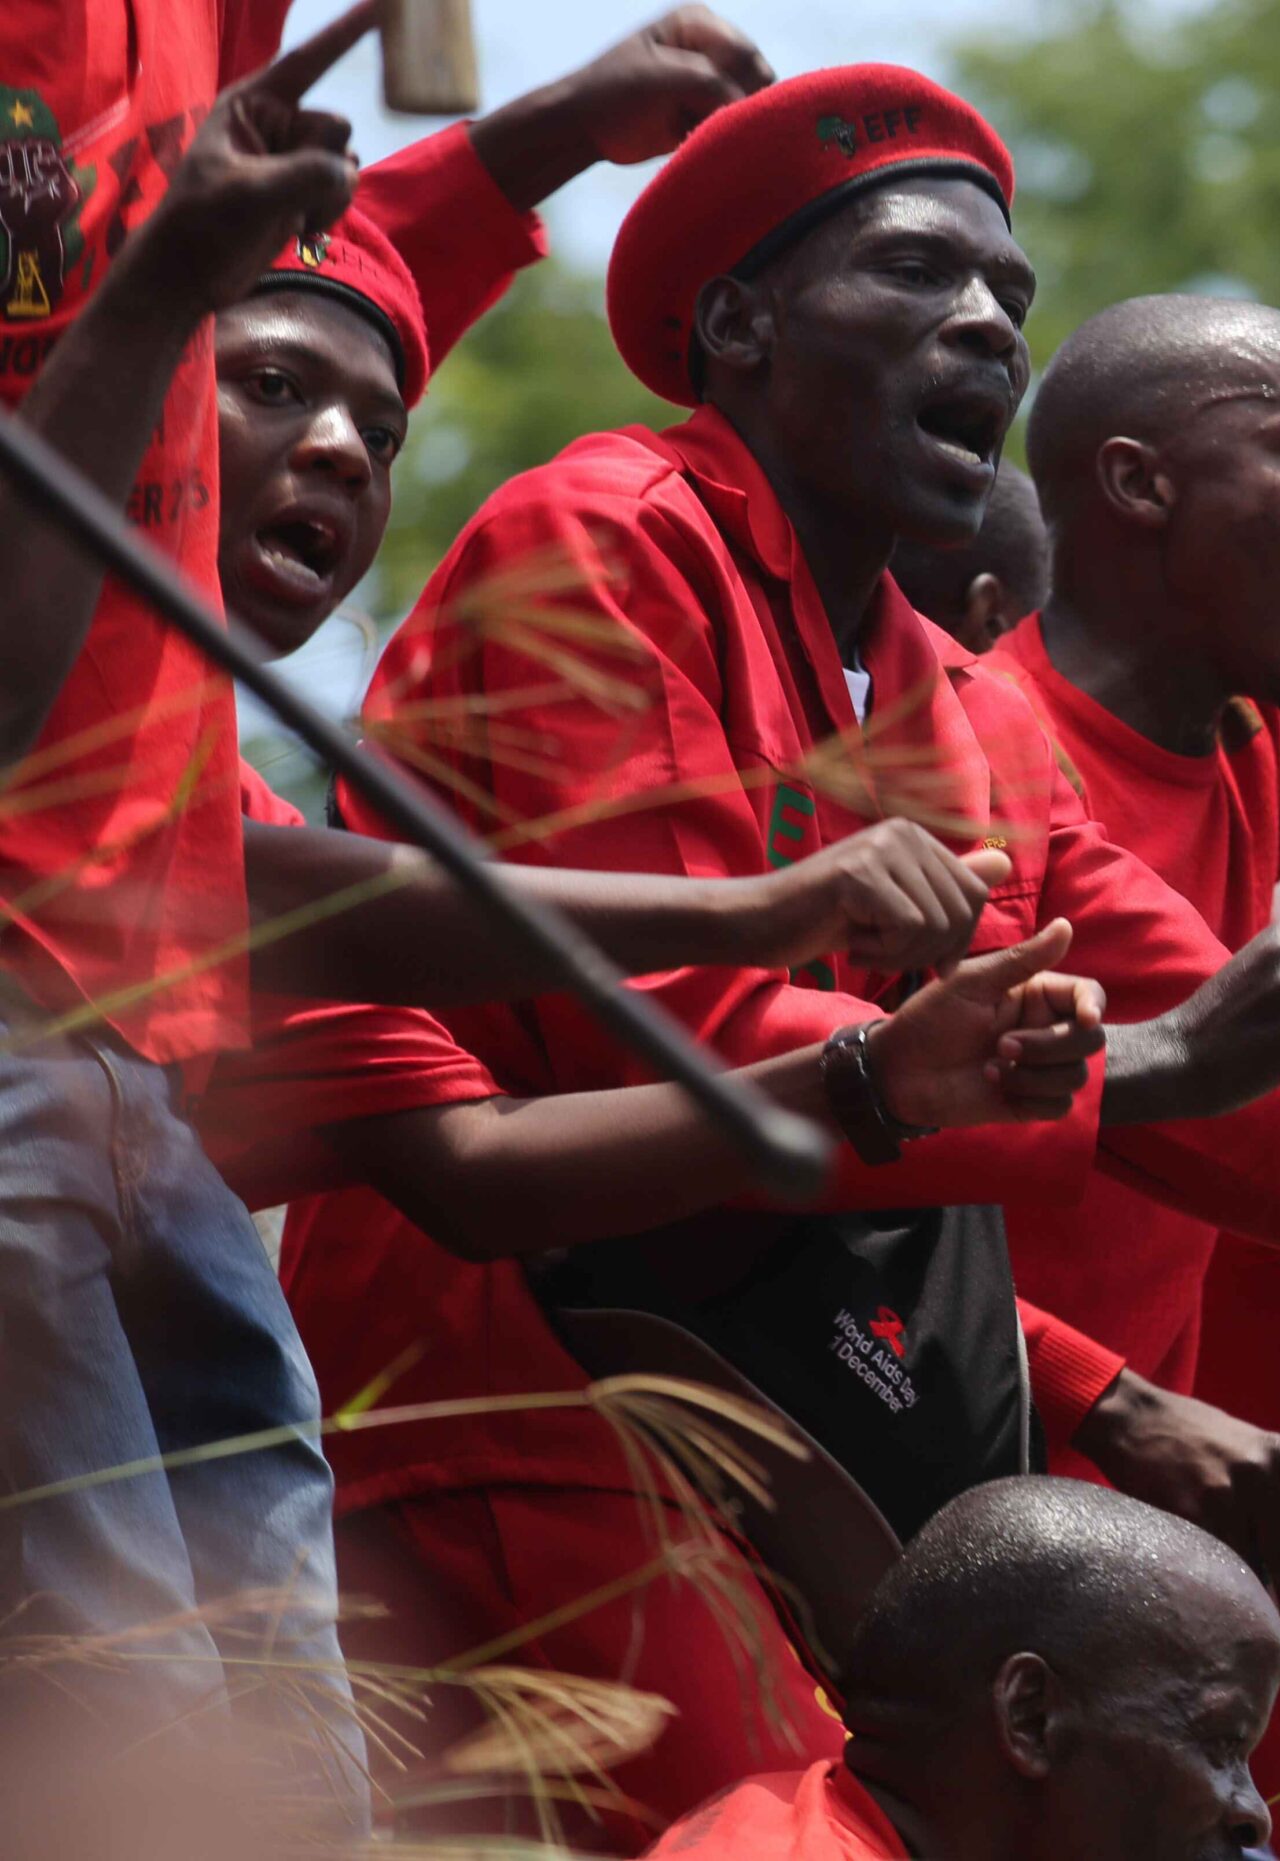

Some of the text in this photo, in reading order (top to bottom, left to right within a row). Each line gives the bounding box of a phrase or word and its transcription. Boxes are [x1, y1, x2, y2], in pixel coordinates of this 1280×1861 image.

[863, 107, 921, 143] EFF
[833, 1308, 920, 1408] World Aids Day
[838, 1343, 903, 1413] December
